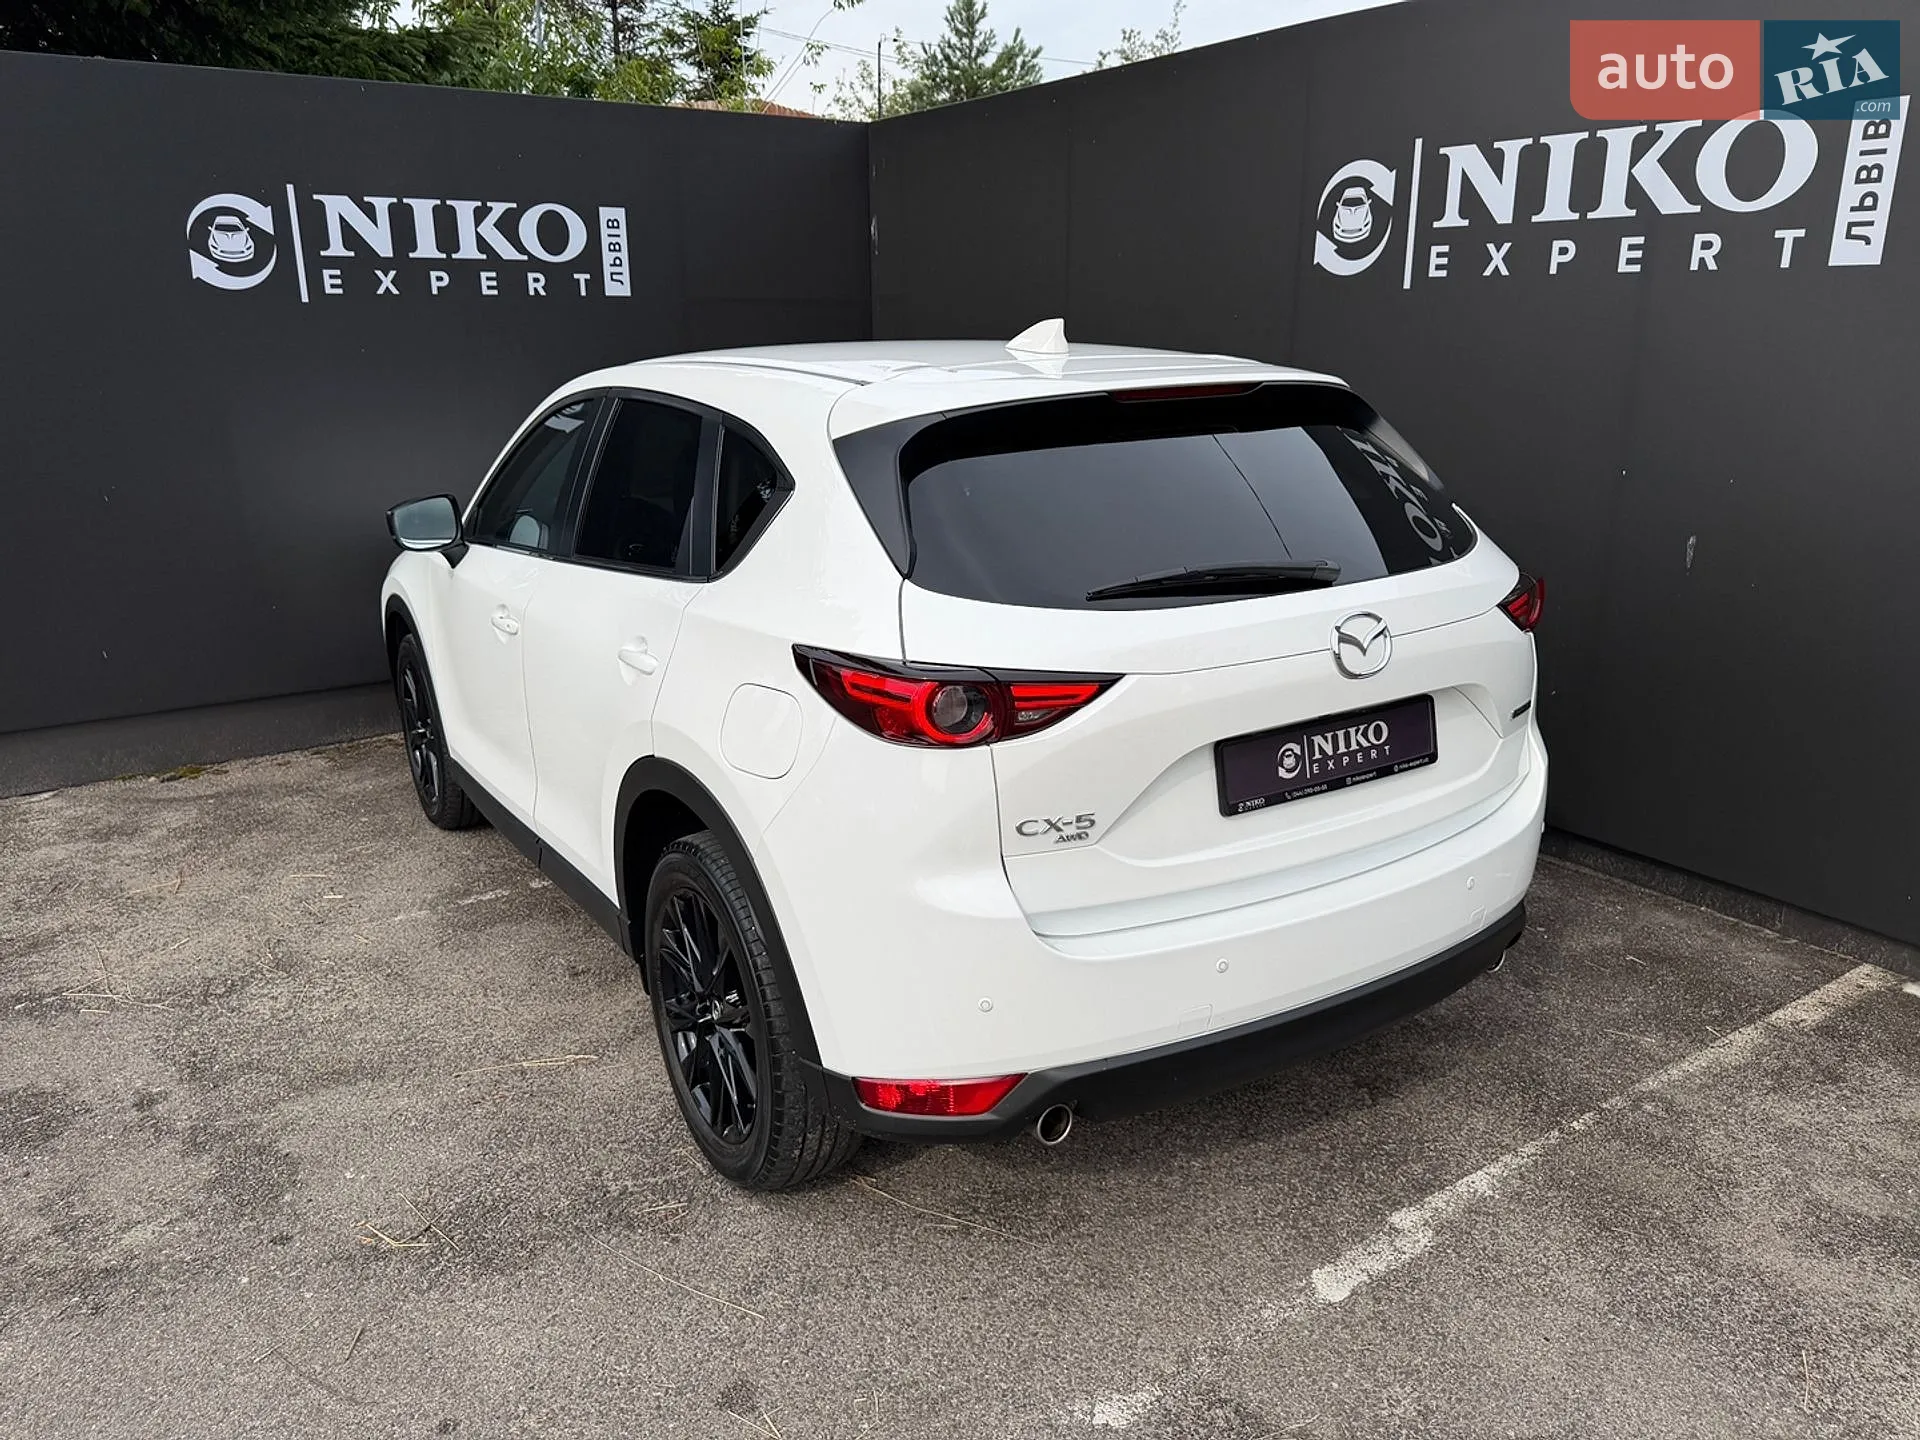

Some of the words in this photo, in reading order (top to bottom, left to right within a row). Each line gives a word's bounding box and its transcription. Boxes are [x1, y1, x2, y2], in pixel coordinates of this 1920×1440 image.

[1432, 109, 1819, 229] NIKO
[1845, 118, 1892, 246] ЛЬВІВ
[312, 193, 588, 263] NIKO
[606, 218, 624, 286] ЛЬВІВ
[1427, 228, 1806, 279] EXPERT
[321, 268, 591, 297] EXPERT
[1310, 720, 1389, 760] NIKO
[1313, 745, 1391, 774] EXPERT
[1015, 812, 1096, 837] CX-5
[1053, 830, 1090, 844] AWD
